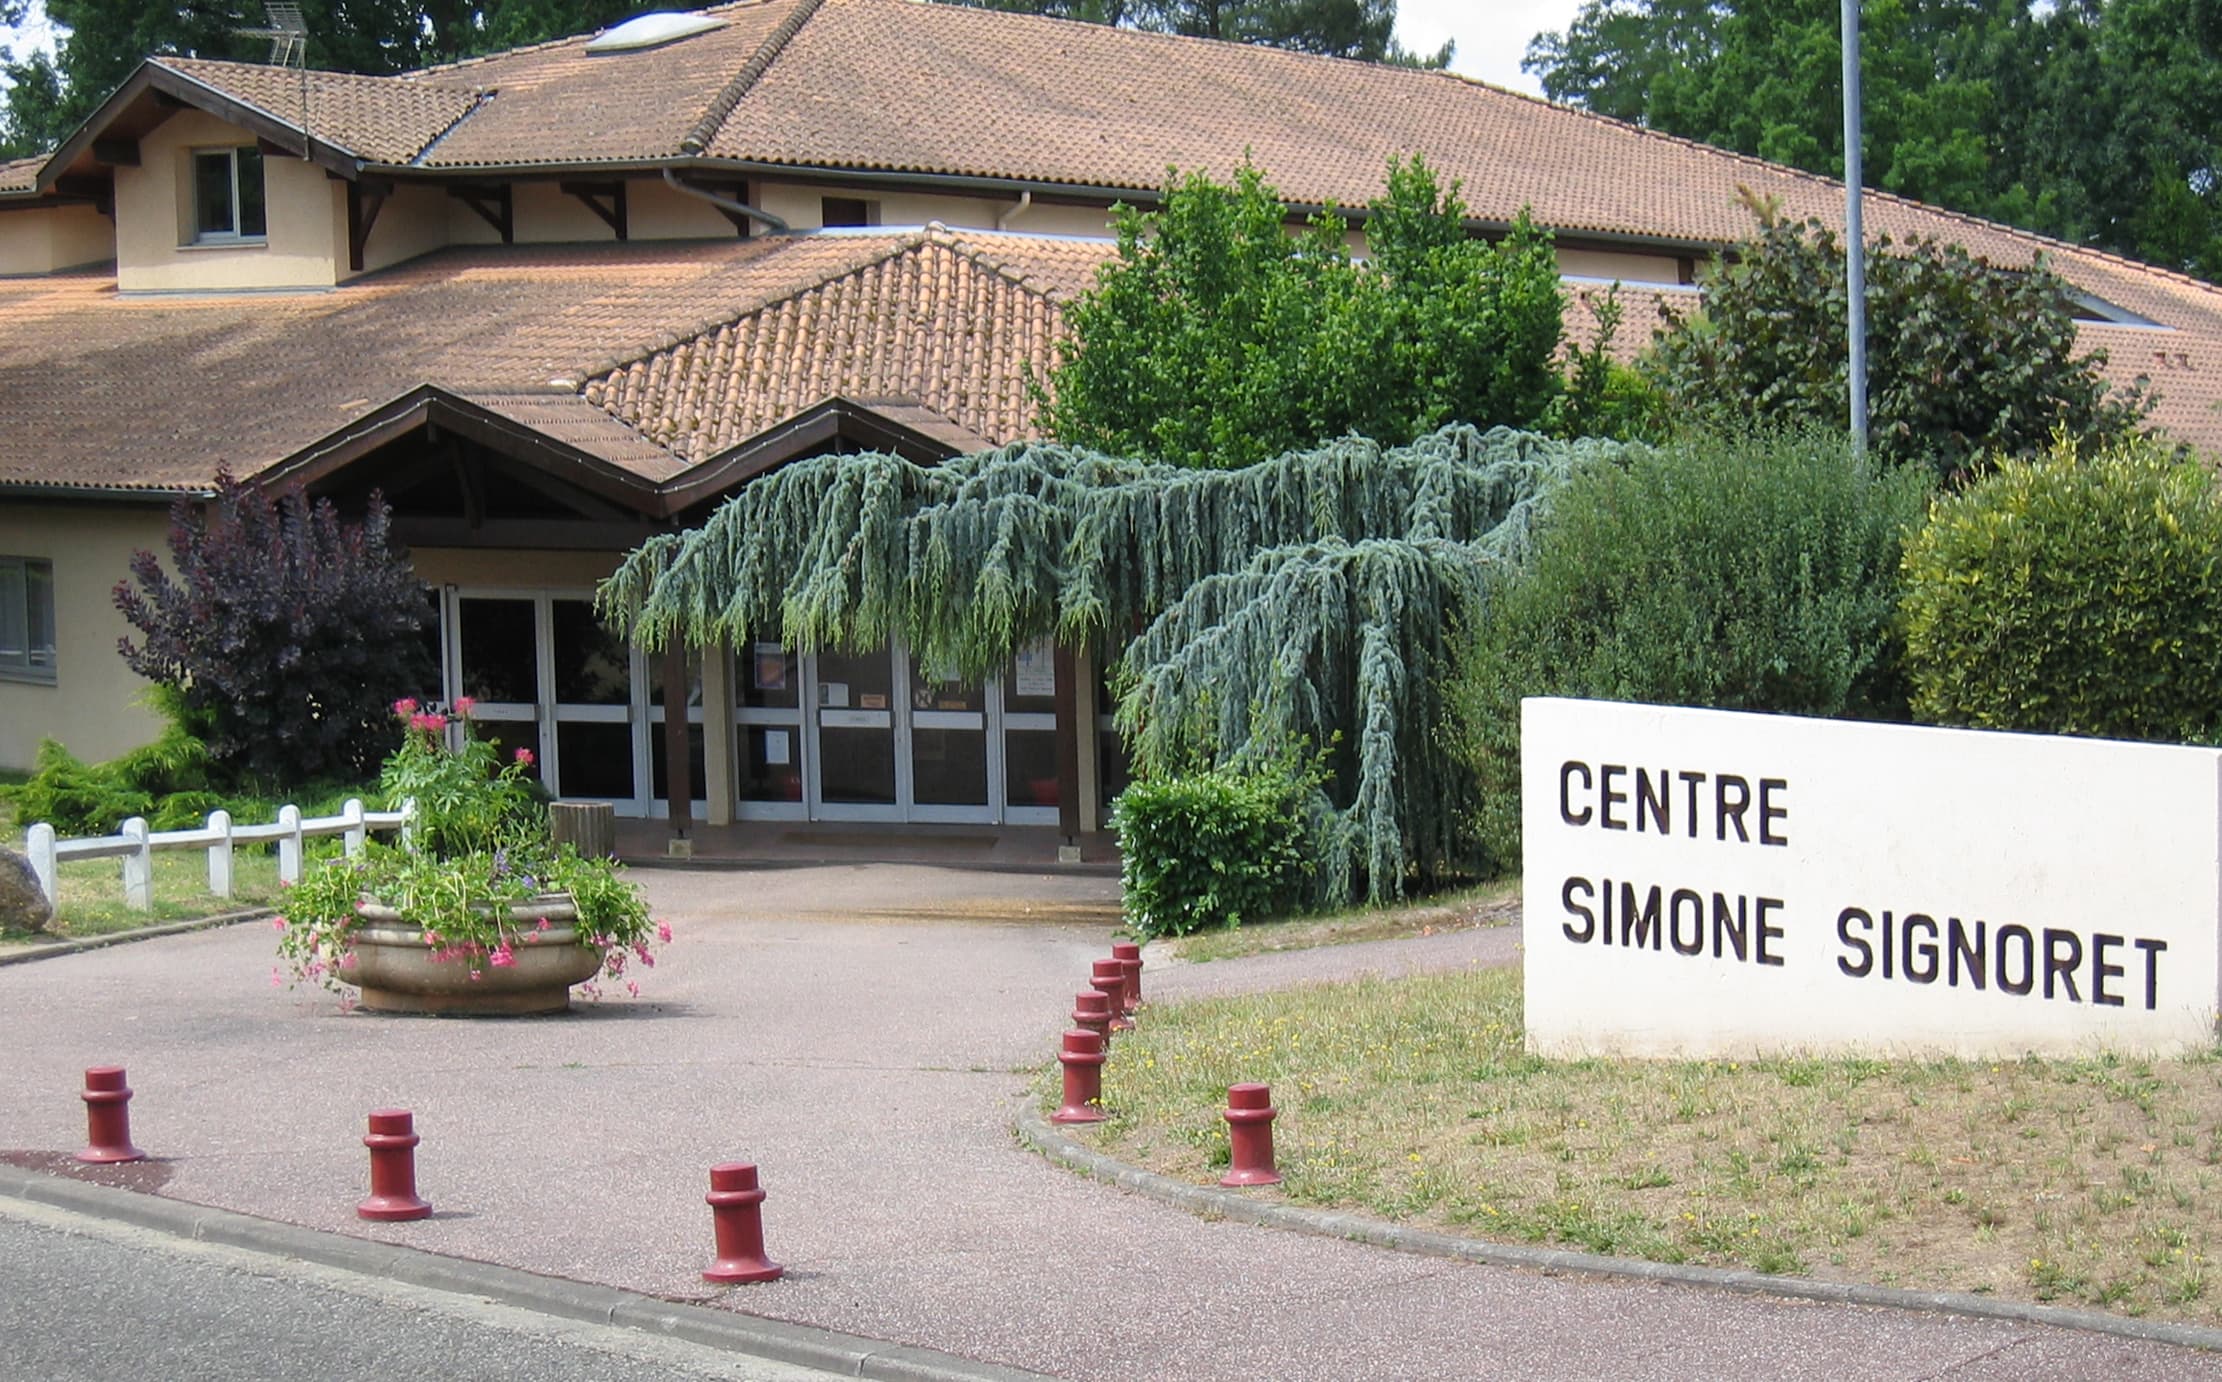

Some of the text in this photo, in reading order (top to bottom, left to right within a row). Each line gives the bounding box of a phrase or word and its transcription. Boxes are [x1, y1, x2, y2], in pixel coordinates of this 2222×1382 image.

[1560, 761, 1788, 846] CENTRE
[1562, 877, 2168, 1010] SIMONE SIGNORET
